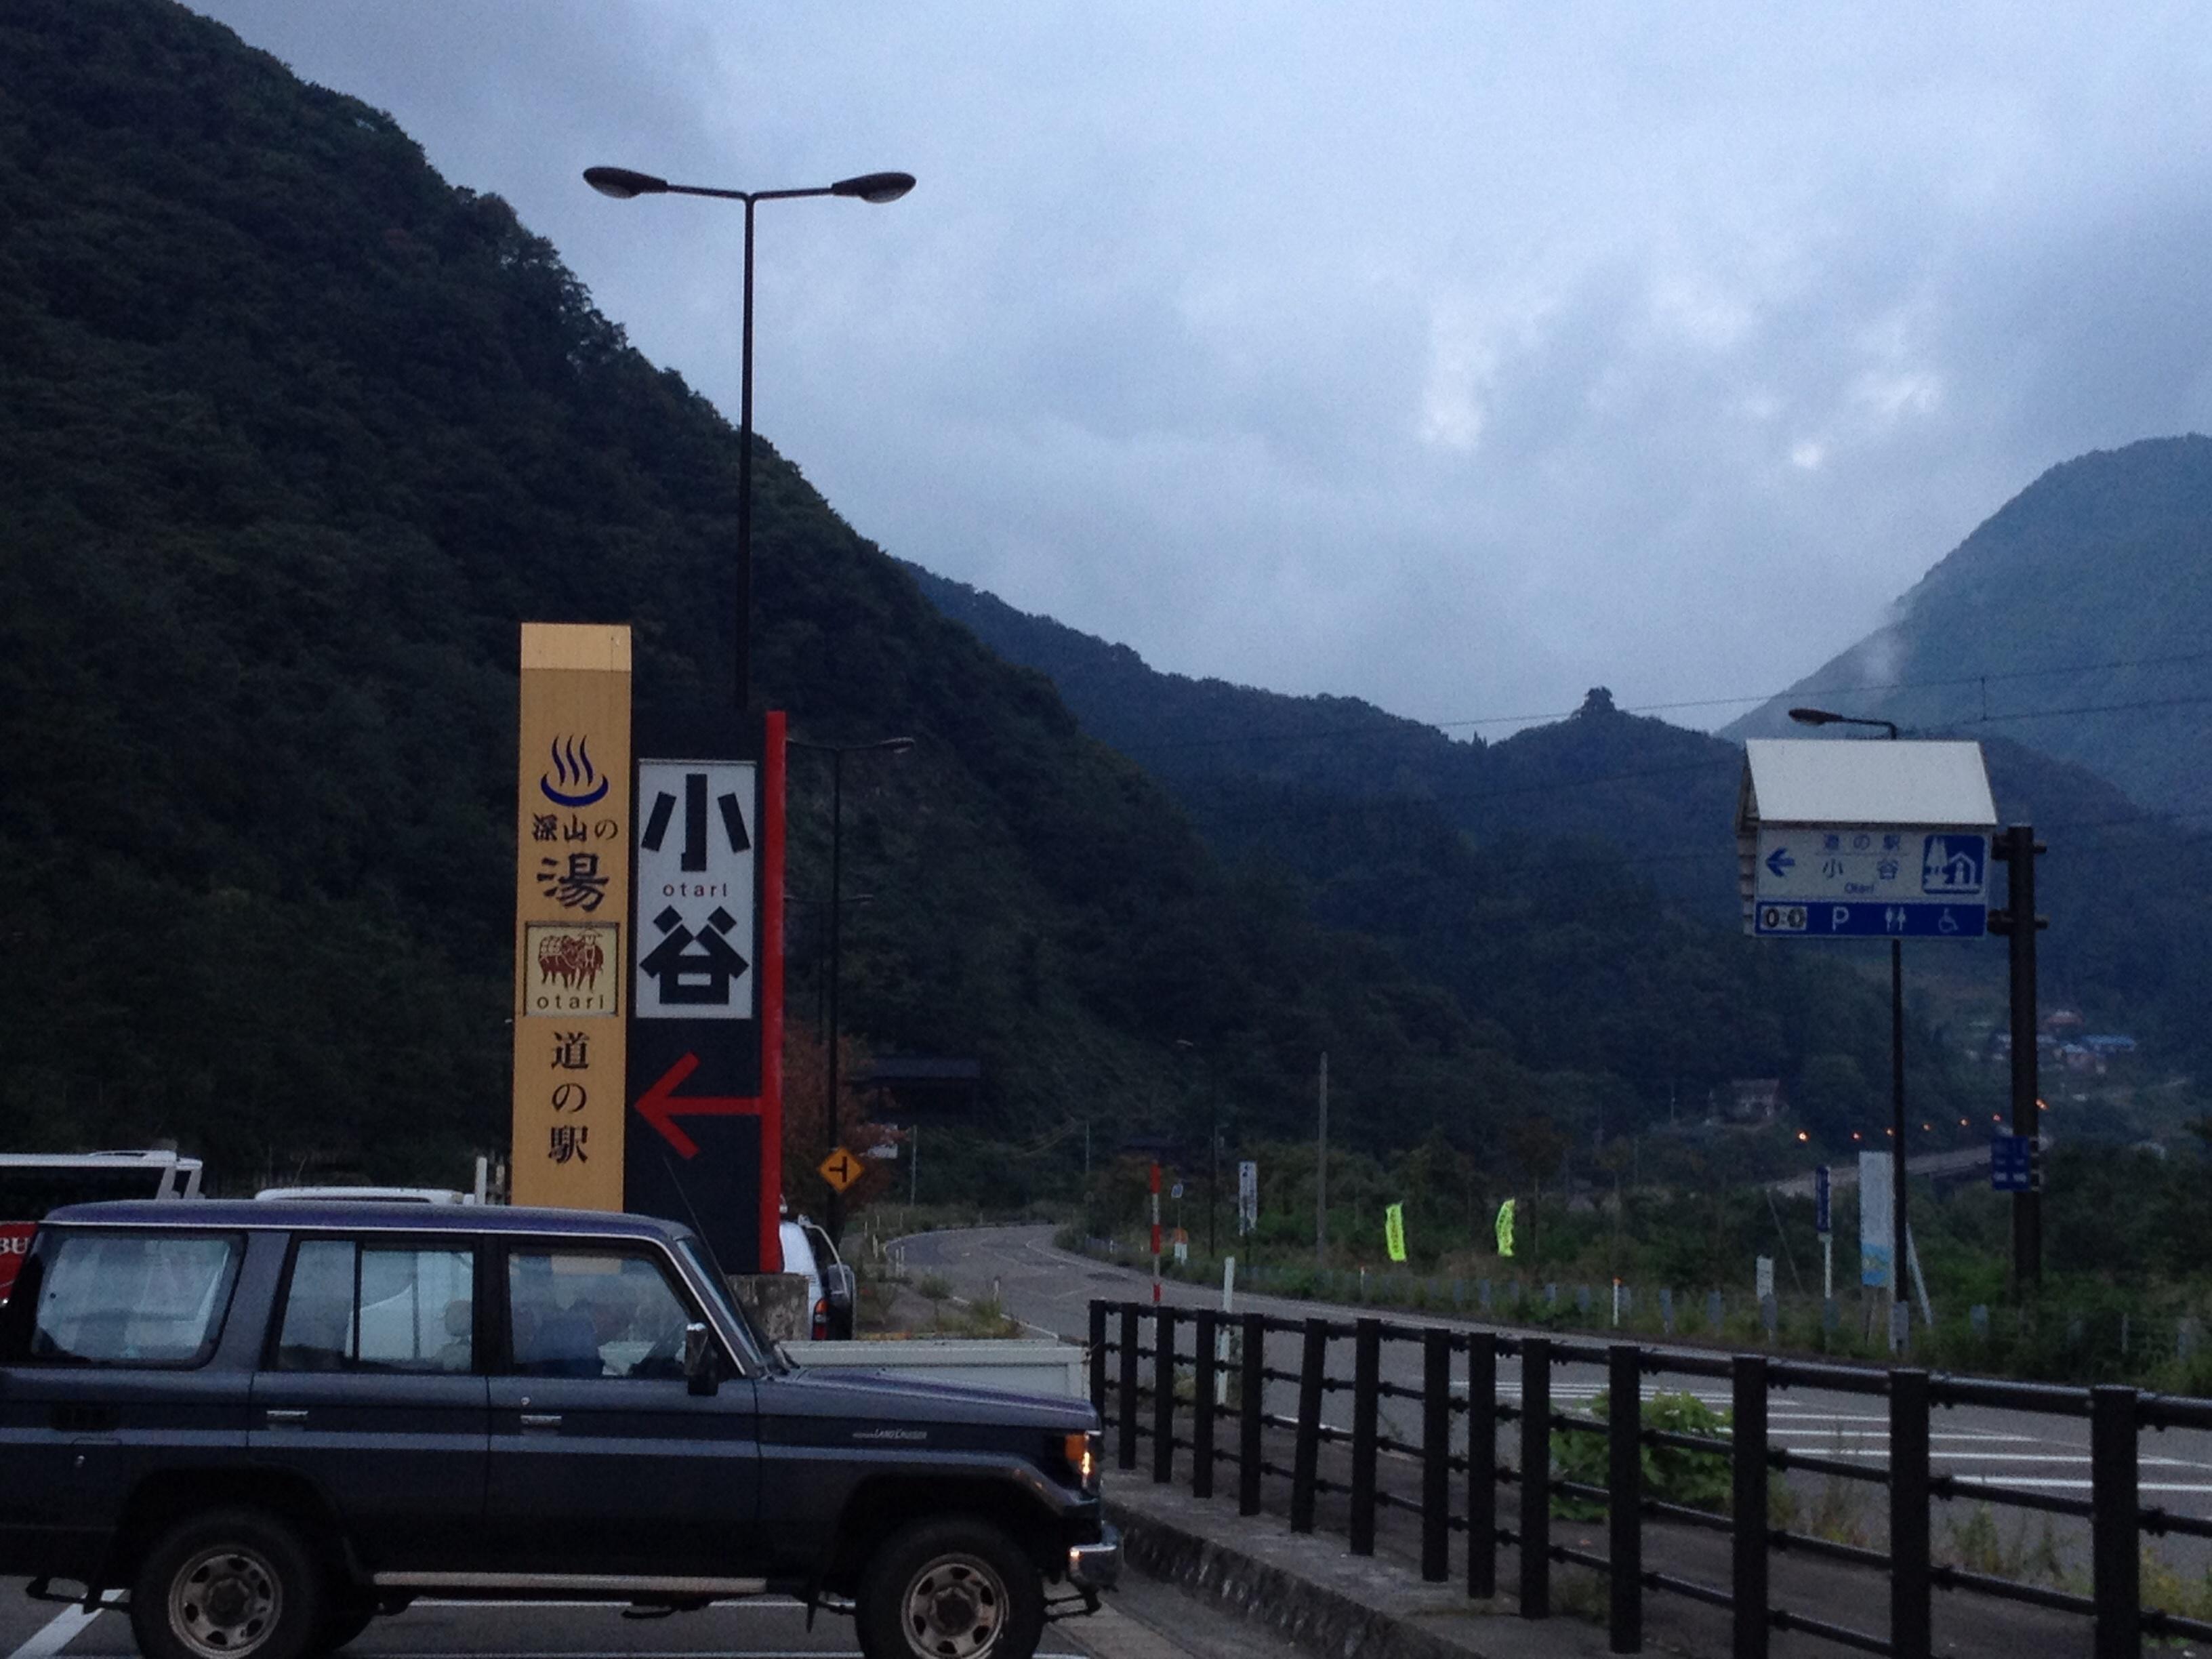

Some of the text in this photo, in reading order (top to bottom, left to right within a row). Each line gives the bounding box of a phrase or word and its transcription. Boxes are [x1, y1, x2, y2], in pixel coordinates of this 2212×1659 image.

[640, 773, 752, 872] 小
[1822, 858, 1899, 880] 小谷
[536, 853, 610, 913] 湯
[663, 882, 727, 898] otari
[1832, 905, 1850, 931] P
[537, 994, 605, 1010] otari
[548, 1031, 590, 1164] 道の駅
